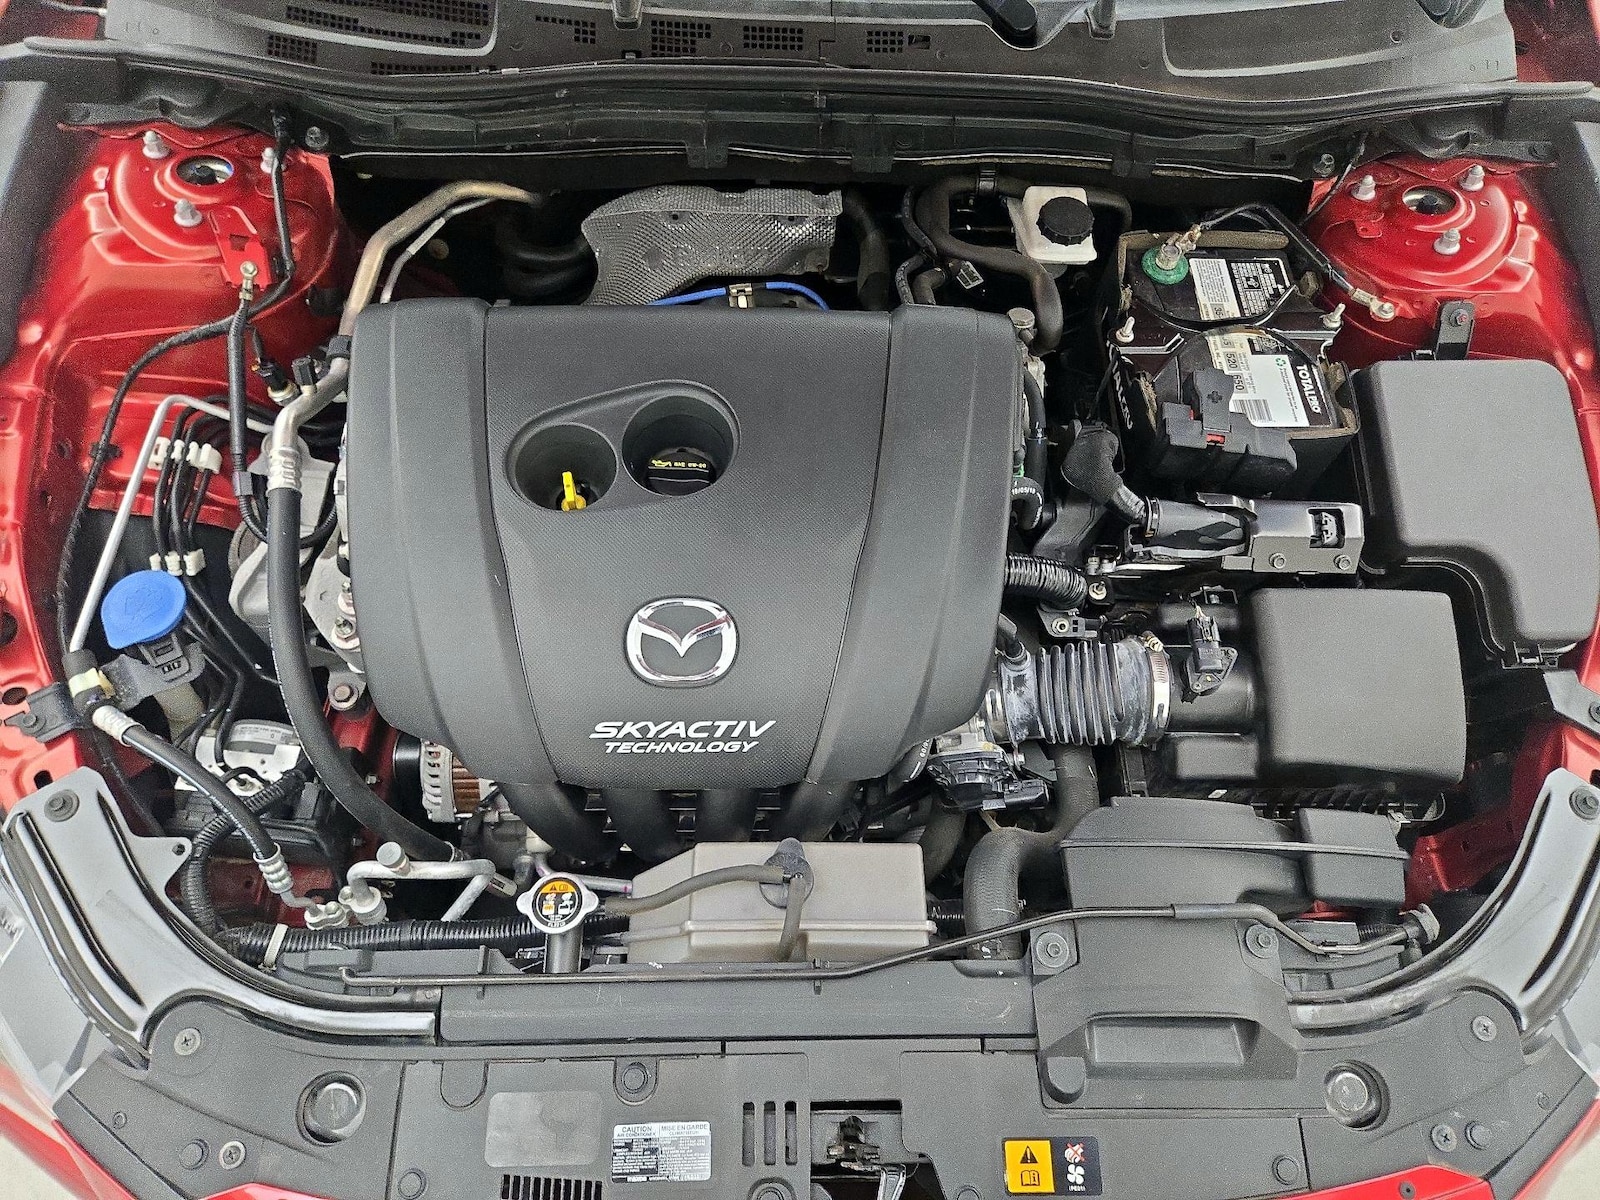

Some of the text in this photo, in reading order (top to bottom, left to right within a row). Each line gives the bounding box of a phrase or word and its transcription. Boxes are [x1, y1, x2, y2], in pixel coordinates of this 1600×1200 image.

[1226, 352, 1238, 369] 520
[1296, 364, 1321, 414] TOTALPRO
[589, 720, 777, 739] SKYACTIV
[605, 741, 760, 754] TECHNOLOGY
